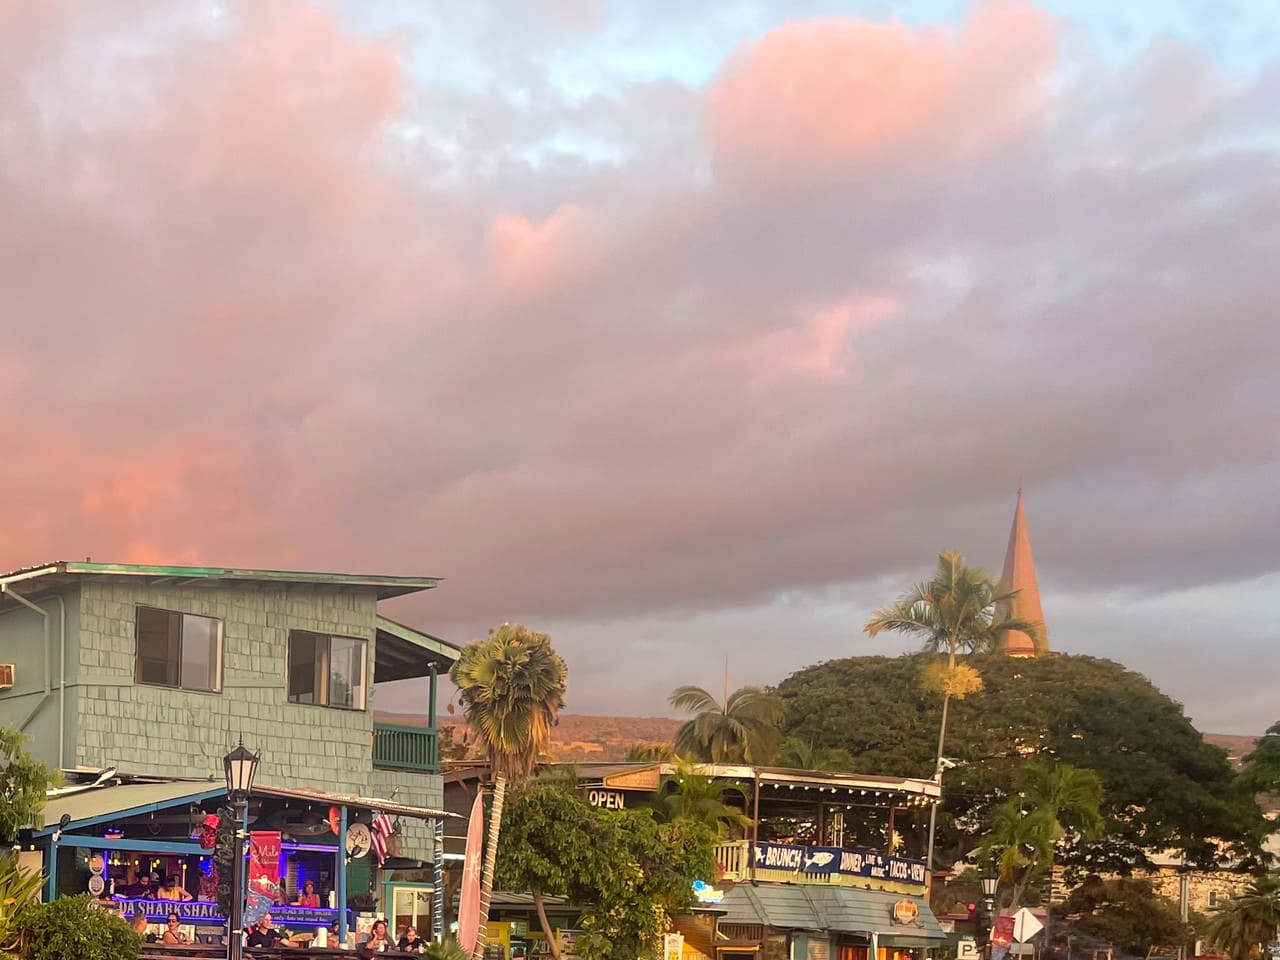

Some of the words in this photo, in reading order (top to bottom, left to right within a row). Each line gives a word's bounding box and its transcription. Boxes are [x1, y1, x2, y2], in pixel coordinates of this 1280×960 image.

[589, 791, 625, 810] OPEN
[765, 846, 802, 869] BRUNCH
[839, 852, 862, 873] DINNER
[889, 860, 908, 880] TACOS
[911, 863, 926, 883] VIEW
[119, 901, 135, 915] DA
[138, 901, 182, 917] SHARK
[183, 903, 224, 919] SHAC
[963, 944, 973, 957] P
